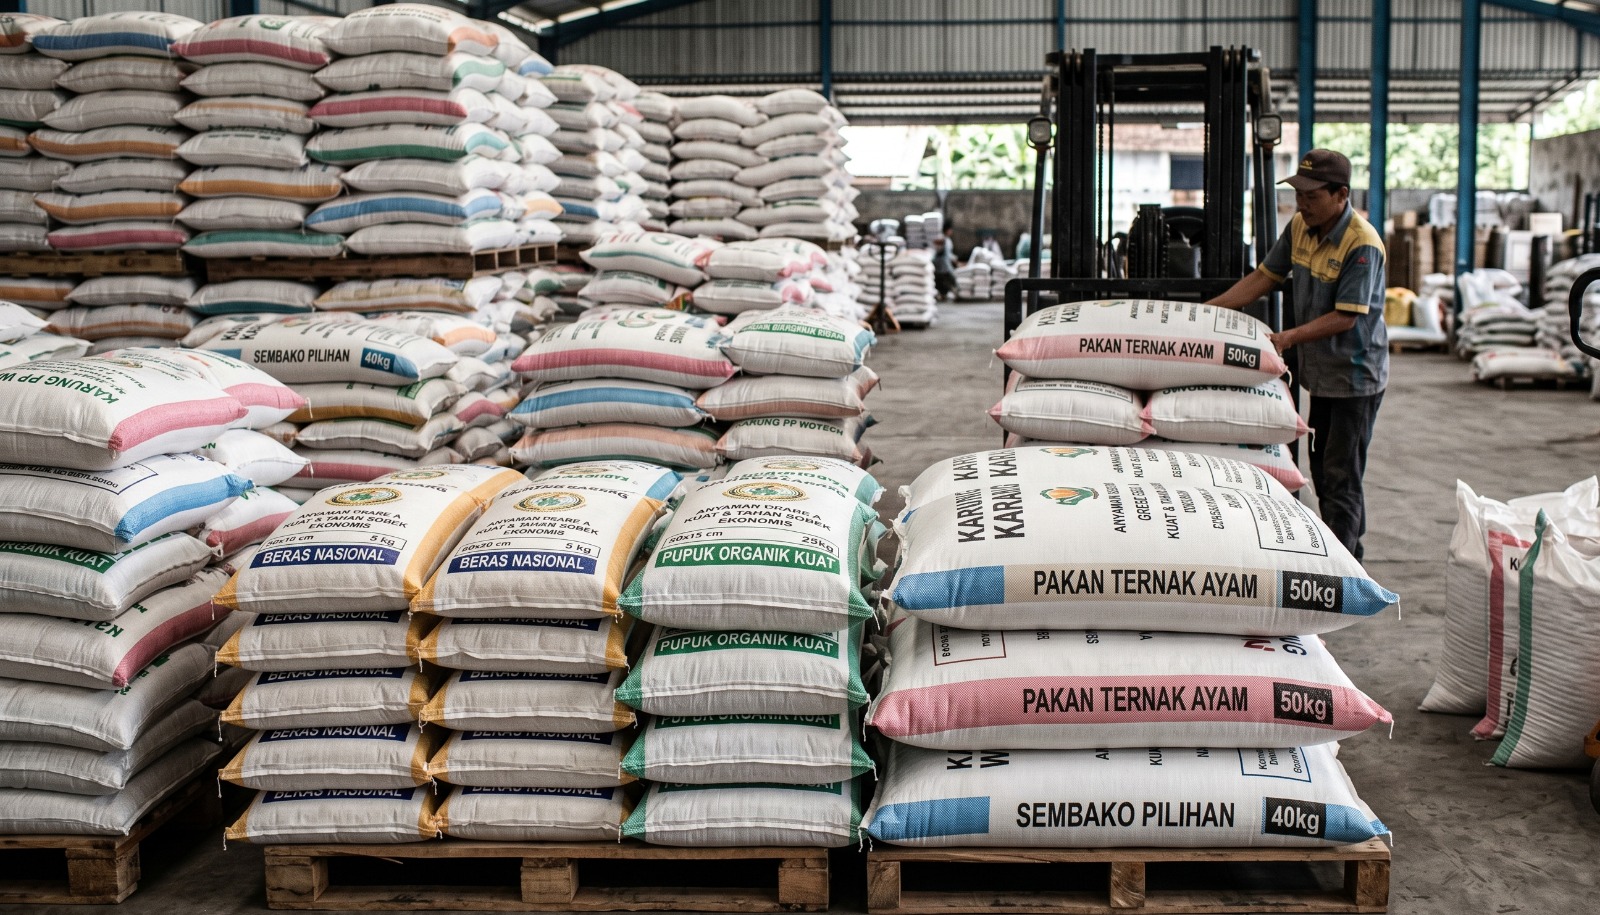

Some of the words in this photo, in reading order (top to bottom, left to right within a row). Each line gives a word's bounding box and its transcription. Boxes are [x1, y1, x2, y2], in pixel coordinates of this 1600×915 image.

[254, 349, 305, 363] SEMBAKO
[307, 349, 350, 363] PILIHAN
[1079, 338, 1122, 354] PAKAN
[1125, 339, 1177, 357] TERNAK
[1179, 343, 1214, 360] AYAM
[1227, 347, 1257, 368] 50kg
[364, 352, 391, 370] 40kg
[17, 374, 44, 384] PP
[44, 376, 120, 405] KARUNG
[783, 419, 798, 427] PP
[799, 421, 844, 436] WOTECH
[695, 504, 761, 516] ANYAMAN
[308, 522, 371, 530] EKONOMIS
[366, 516, 408, 529] SOBEK
[683, 510, 718, 524] KUAT
[736, 510, 782, 518] TAHAN
[785, 513, 832, 531] SOBEK
[717, 517, 793, 527] EKONOMIS
[1163, 512, 1180, 540] KUAT
[503, 528, 566, 536] EKONOMIS
[380, 536, 396, 547] kg
[576, 544, 592, 555] kg
[801, 536, 834, 554] 25kg
[0, 541, 63, 557] RGANIK
[64, 550, 110, 568] KUAT
[261, 548, 310, 565] BERAS
[313, 547, 386, 563] NASIONAL
[459, 553, 509, 569] BERAS
[511, 553, 585, 570] NASIONAL
[661, 546, 716, 564] PUPUK
[718, 545, 790, 563] ORGANIK
[794, 549, 836, 569] KUAT
[1033, 570, 1105, 596] PAKAN
[1111, 569, 1197, 596] TERNAK
[1201, 571, 1258, 599] AYAM
[1289, 579, 1336, 608] 50kg
[660, 634, 714, 652] PUPUK
[717, 633, 789, 646] ORGANIK
[793, 636, 834, 654] KUAT
[1023, 688, 1094, 713] PAKAN
[1100, 685, 1187, 713] TERNAK
[1191, 685, 1249, 712] AYAM
[1280, 690, 1327, 721] 50kg
[270, 727, 320, 740] BERAS
[322, 725, 398, 738] NASIONAL
[1016, 801, 1135, 828] SEMBAKO
[1142, 801, 1236, 828] PILIHAN
[1270, 805, 1320, 835] 40kg
